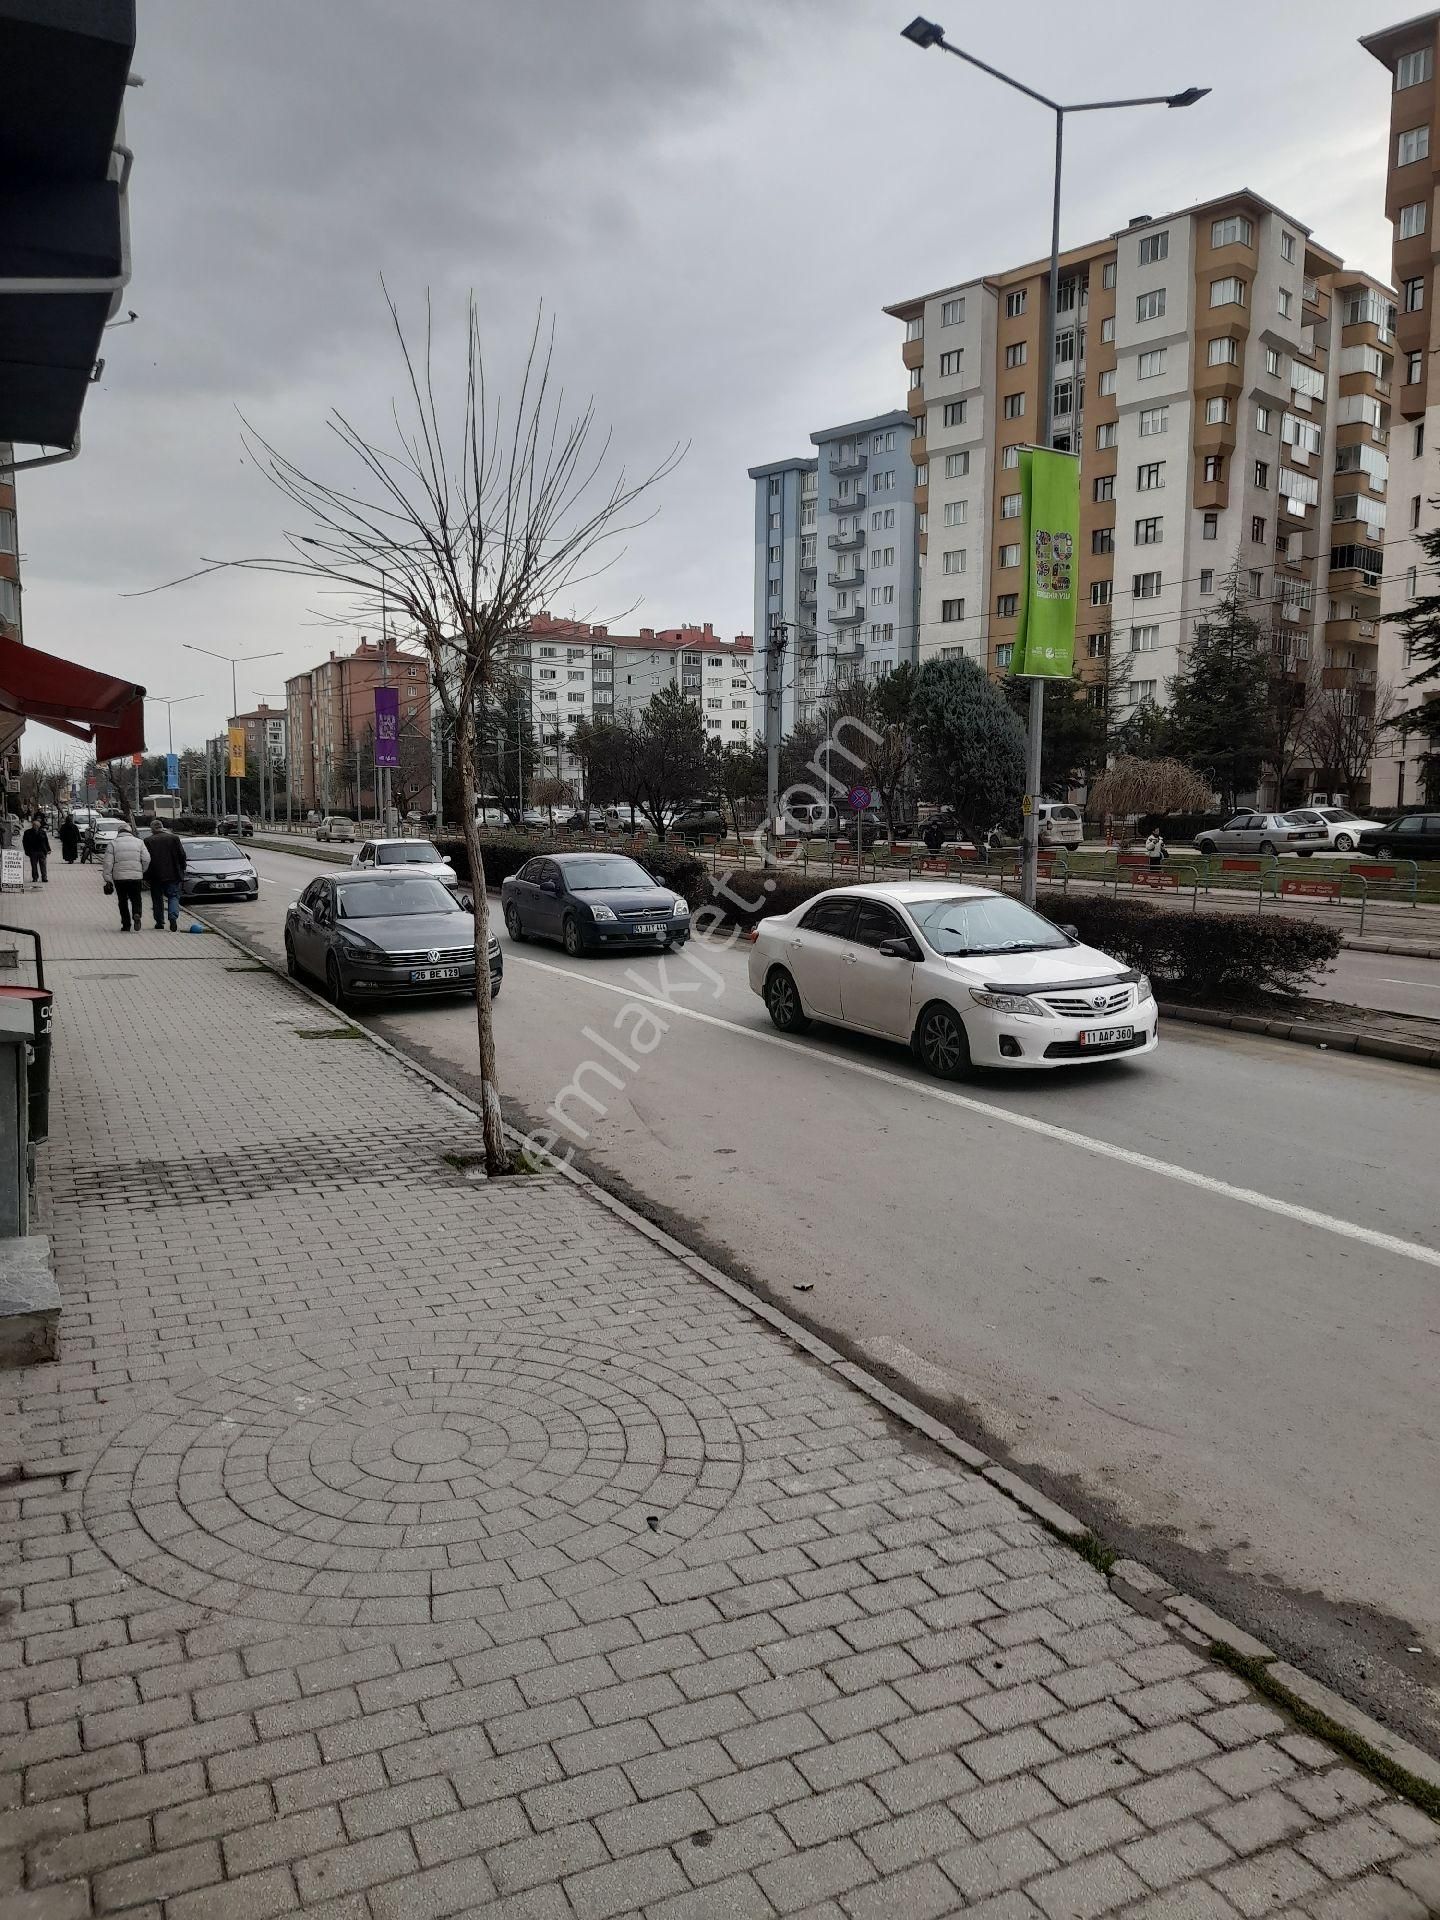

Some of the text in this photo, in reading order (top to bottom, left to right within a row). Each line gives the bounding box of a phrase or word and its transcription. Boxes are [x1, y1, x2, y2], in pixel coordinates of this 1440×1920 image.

[415, 968, 458, 980] 26 BE 129
[1087, 1028, 1132, 1043] 11 AAP 360
